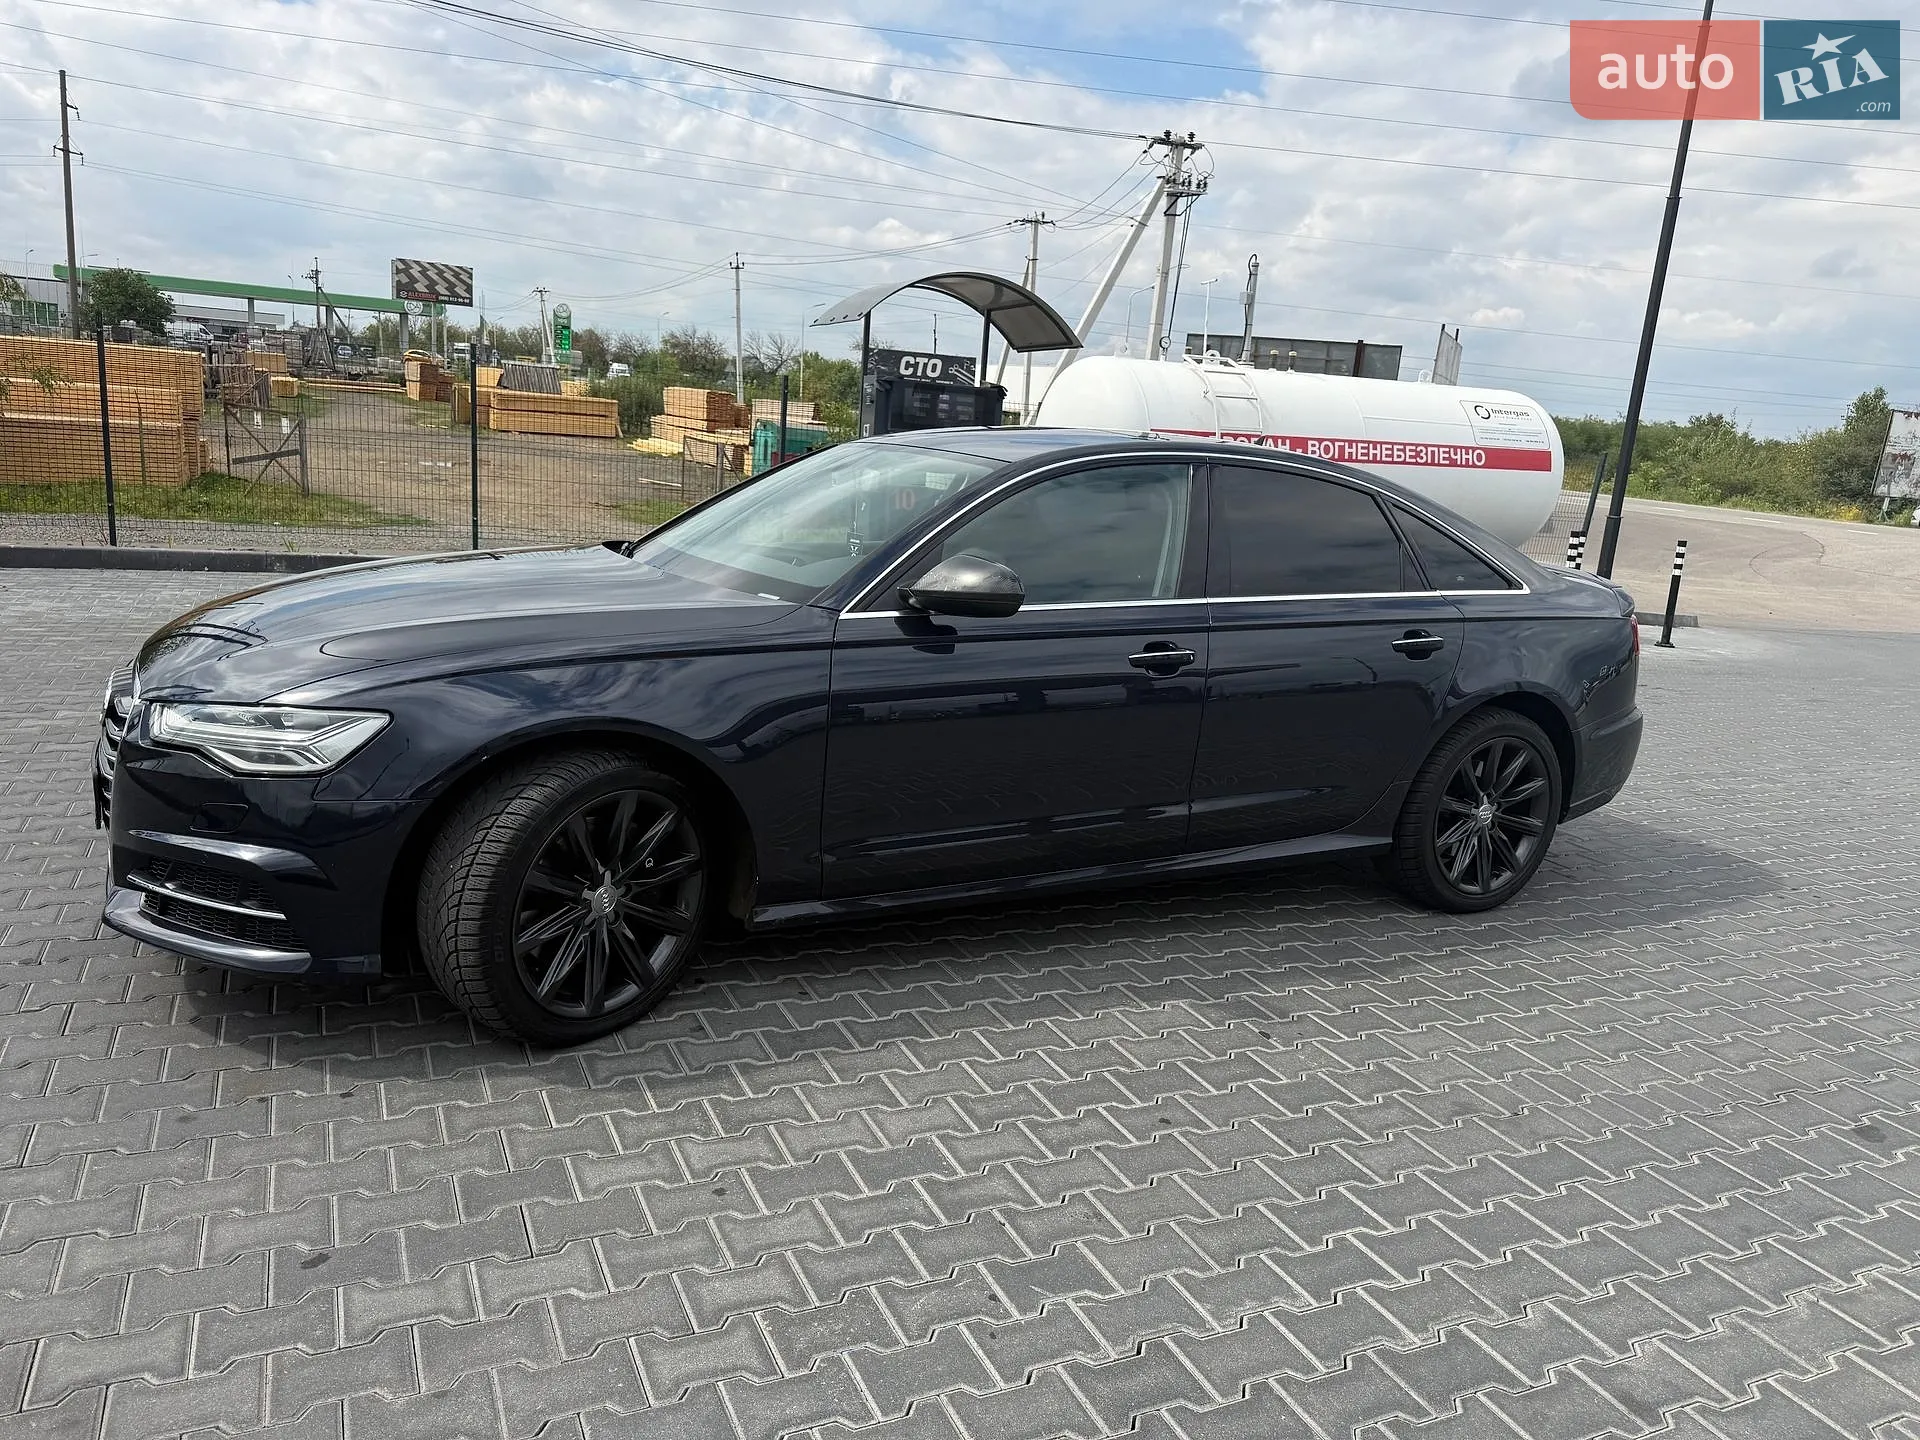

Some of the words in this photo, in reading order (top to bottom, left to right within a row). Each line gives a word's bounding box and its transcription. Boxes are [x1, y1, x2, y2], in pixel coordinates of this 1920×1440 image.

[899, 356, 943, 378] СТО
[1491, 408, 1530, 417] Intergas
[1307, 440, 1486, 466] ВОГНЕНЕБЕЗПЕЧНО
